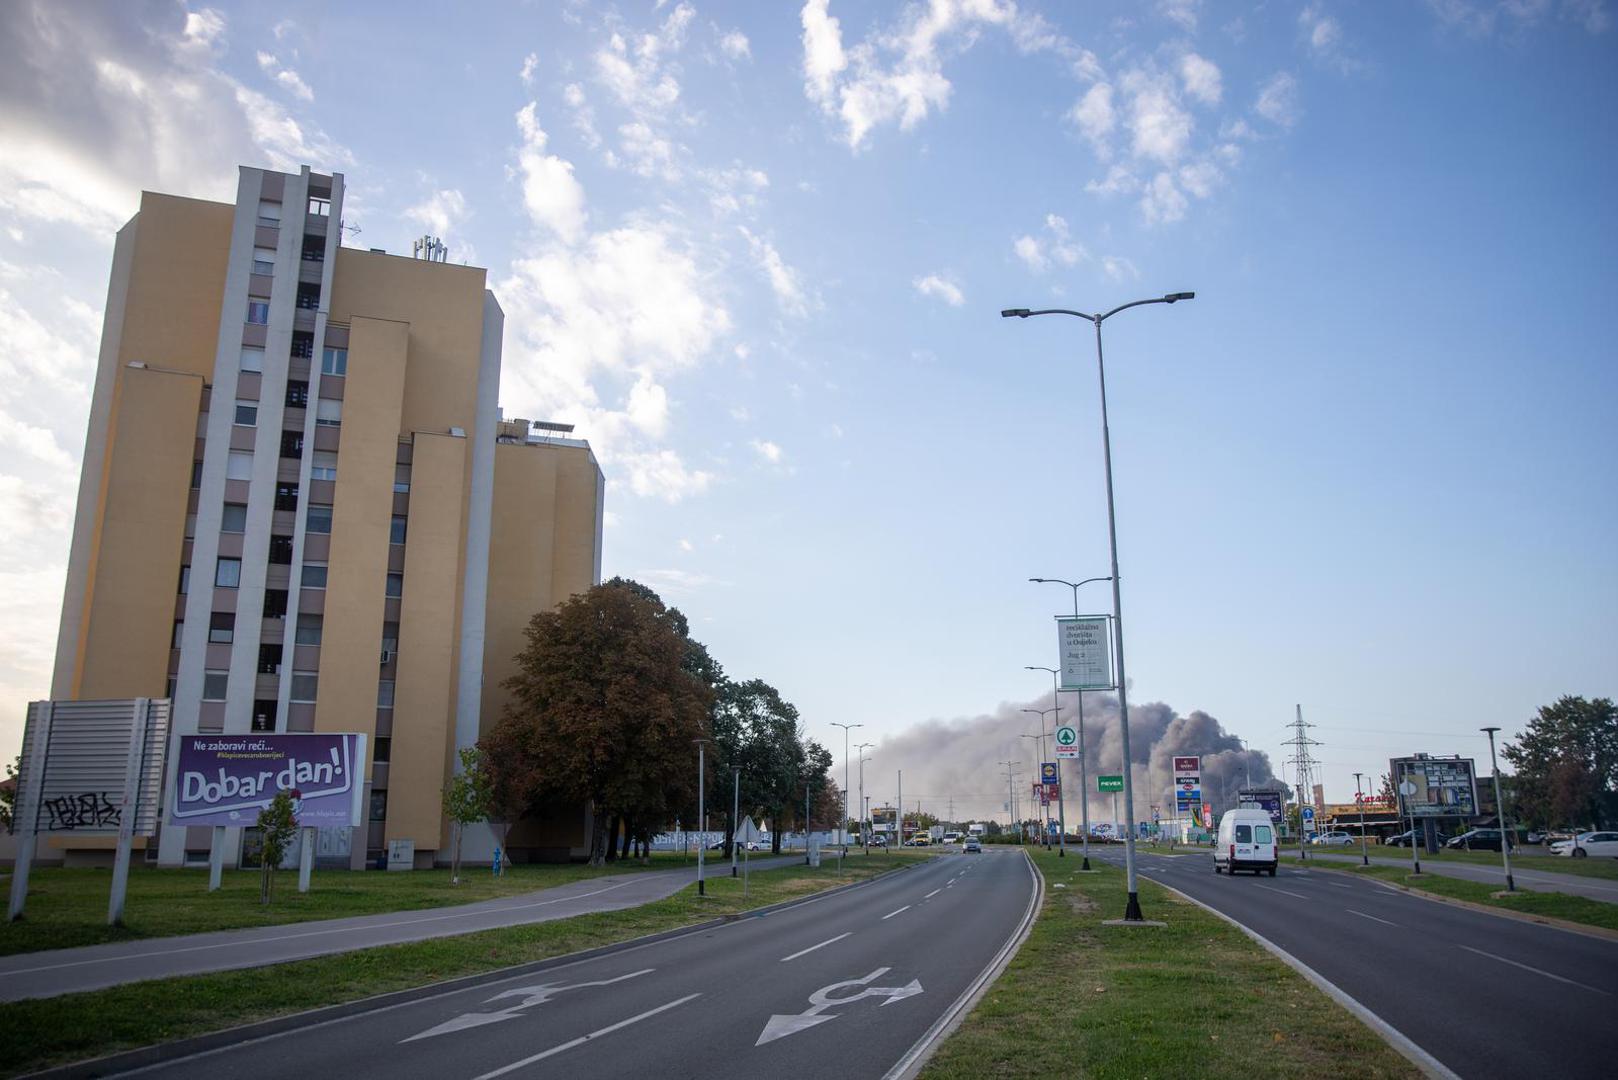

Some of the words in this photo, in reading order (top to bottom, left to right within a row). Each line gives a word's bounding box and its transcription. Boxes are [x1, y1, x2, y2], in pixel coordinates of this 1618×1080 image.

[193, 741, 206, 751] Ne
[208, 740, 246, 751] zaboravi
[248, 740, 274, 751] reći...
[181, 767, 274, 804] Dobar
[276, 747, 344, 790] dan!
